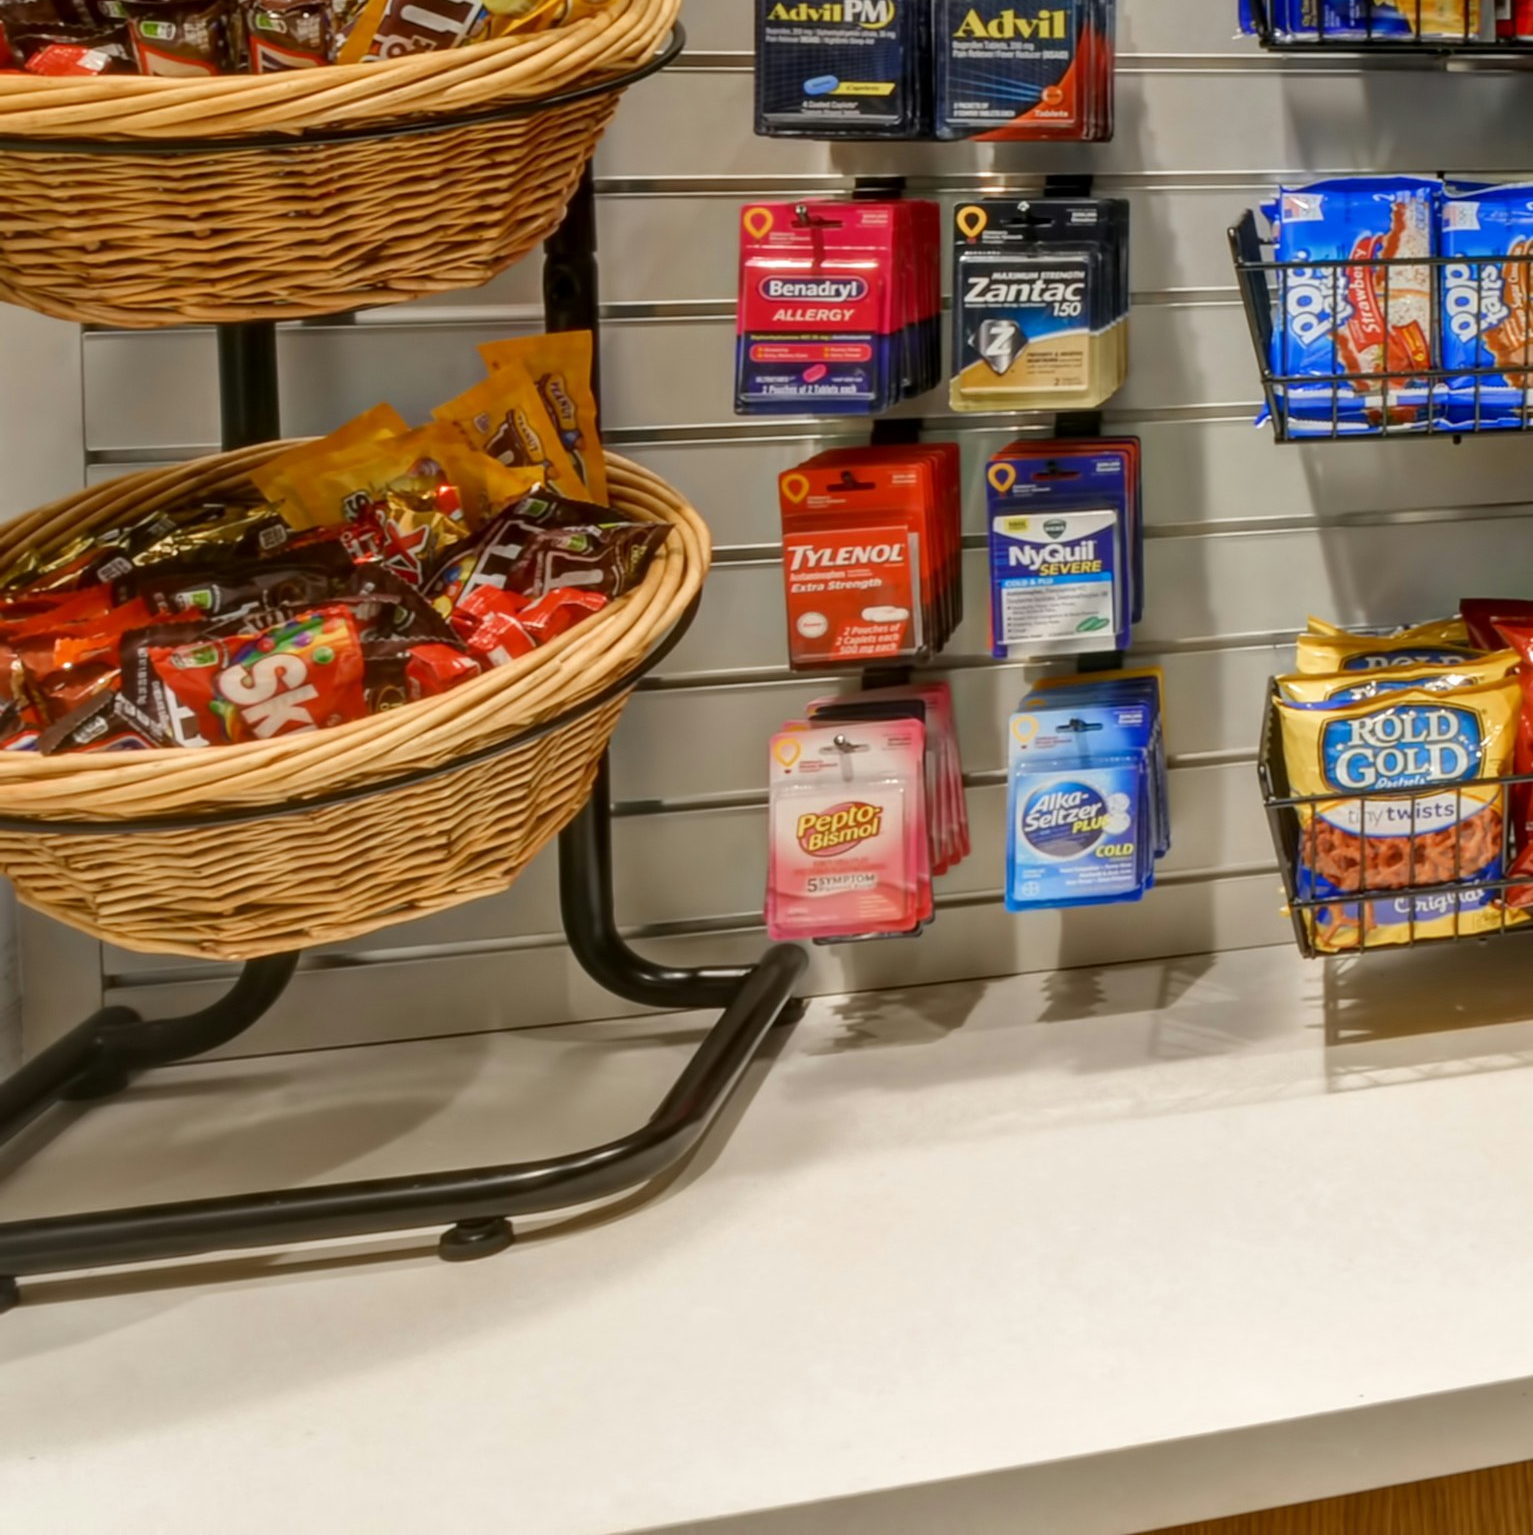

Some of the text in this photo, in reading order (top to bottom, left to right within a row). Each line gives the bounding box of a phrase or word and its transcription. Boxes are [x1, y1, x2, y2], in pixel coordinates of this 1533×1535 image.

[767, 1, 842, 23] Advil
[951, 7, 1067, 39] Advil
[990, 271, 1040, 281] MAXIMUM
[769, 279, 858, 303] Benadryl
[963, 276, 1086, 303] Zantac
[772, 308, 856, 322] ALLERGY
[1052, 301, 1082, 317] 150
[984, 326, 1016, 357] Z
[787, 543, 905, 571] TYLENOL
[1007, 539, 1096, 572] NyQuil
[1038, 559, 1103, 577] SEVERE
[790, 577, 883, 594] Extra Strength
[1347, 709, 1460, 747] ROLD
[1334, 743, 1470, 789] GOLD
[1028, 790, 1090, 814] Alka-
[1347, 801, 1456, 826] tiny twists
[796, 804, 884, 840] Pepto-
[1023, 801, 1103, 833] Seltzer
[807, 815, 882, 852] Bismol
[1095, 842, 1135, 859] COLD
[806, 873, 876, 894] 5 SYMPTOM
